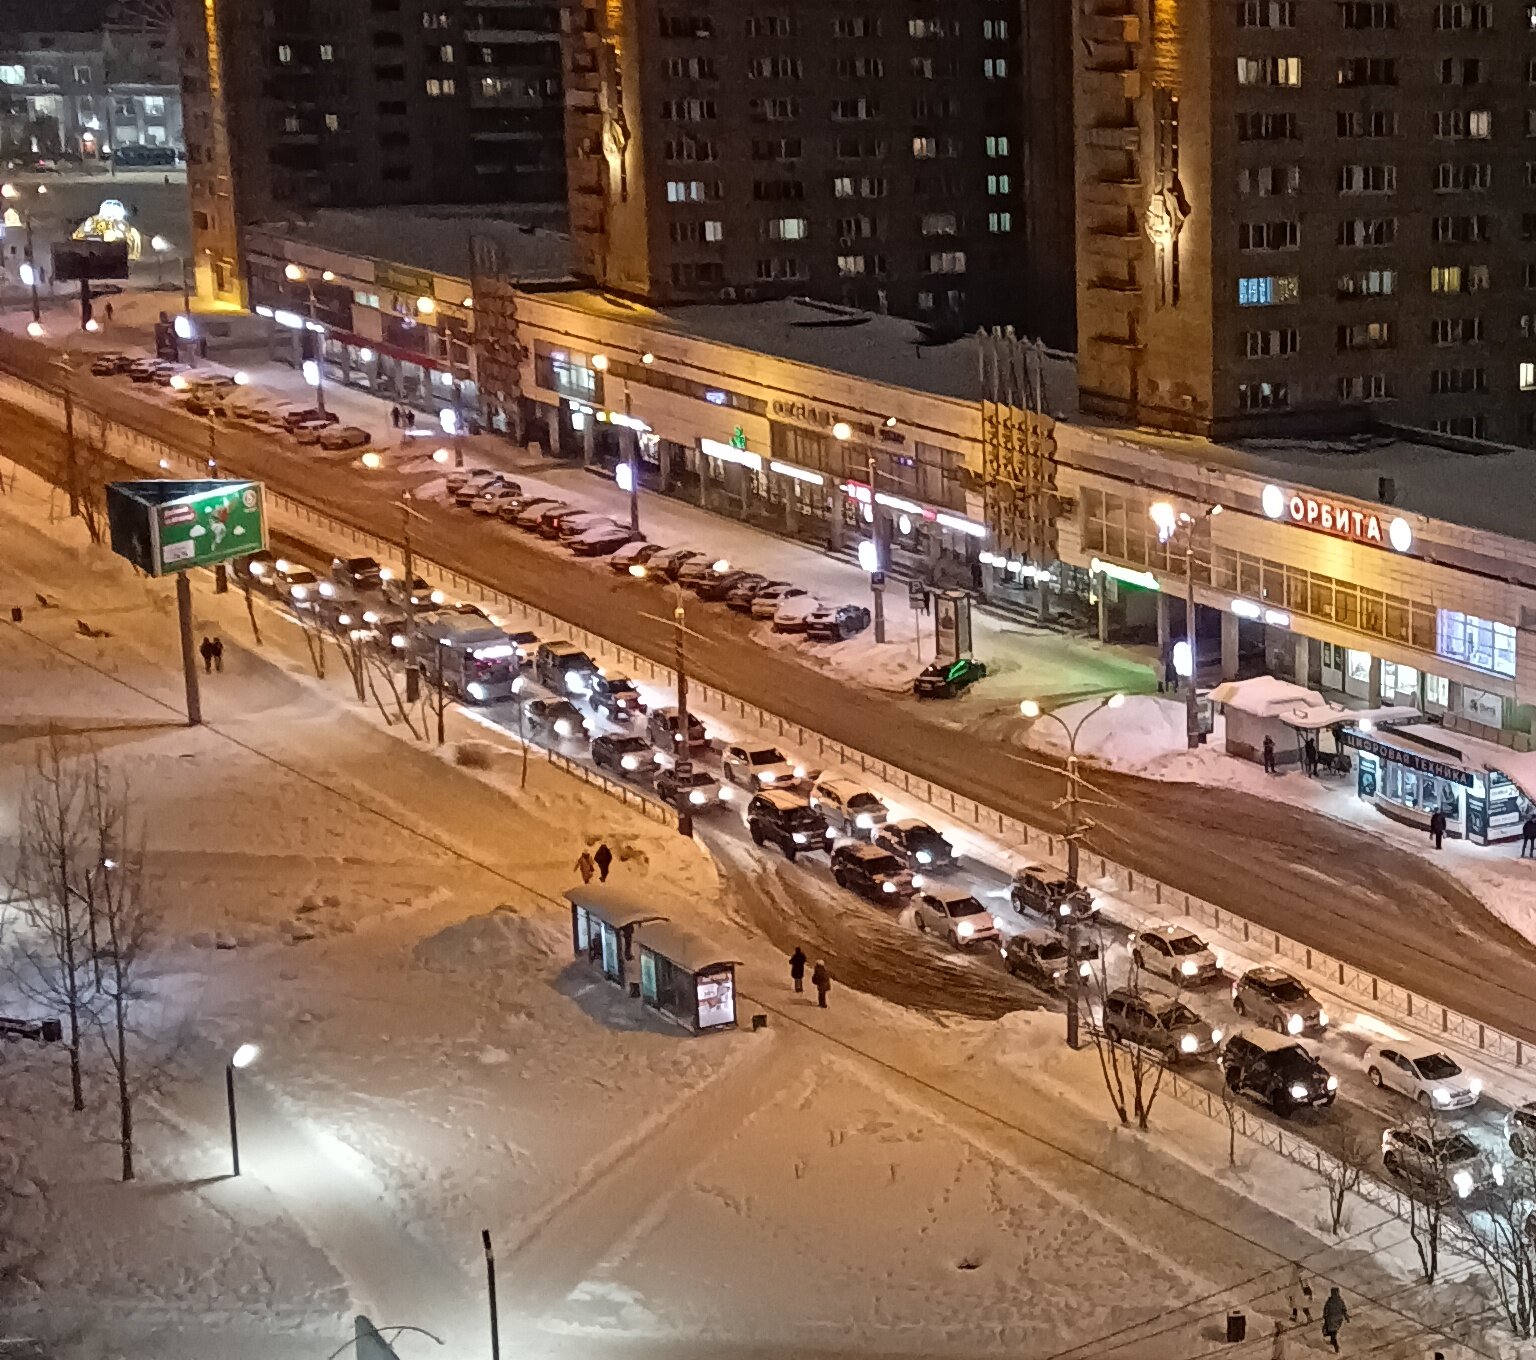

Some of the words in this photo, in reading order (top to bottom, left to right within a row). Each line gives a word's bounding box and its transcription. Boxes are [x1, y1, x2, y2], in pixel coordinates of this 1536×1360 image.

[1289, 496, 1382, 543] ОРБИТА
[1347, 735, 1410, 765] ЦИФРОВАЯ
[1414, 757, 1468, 784] ТЕХНИКА
